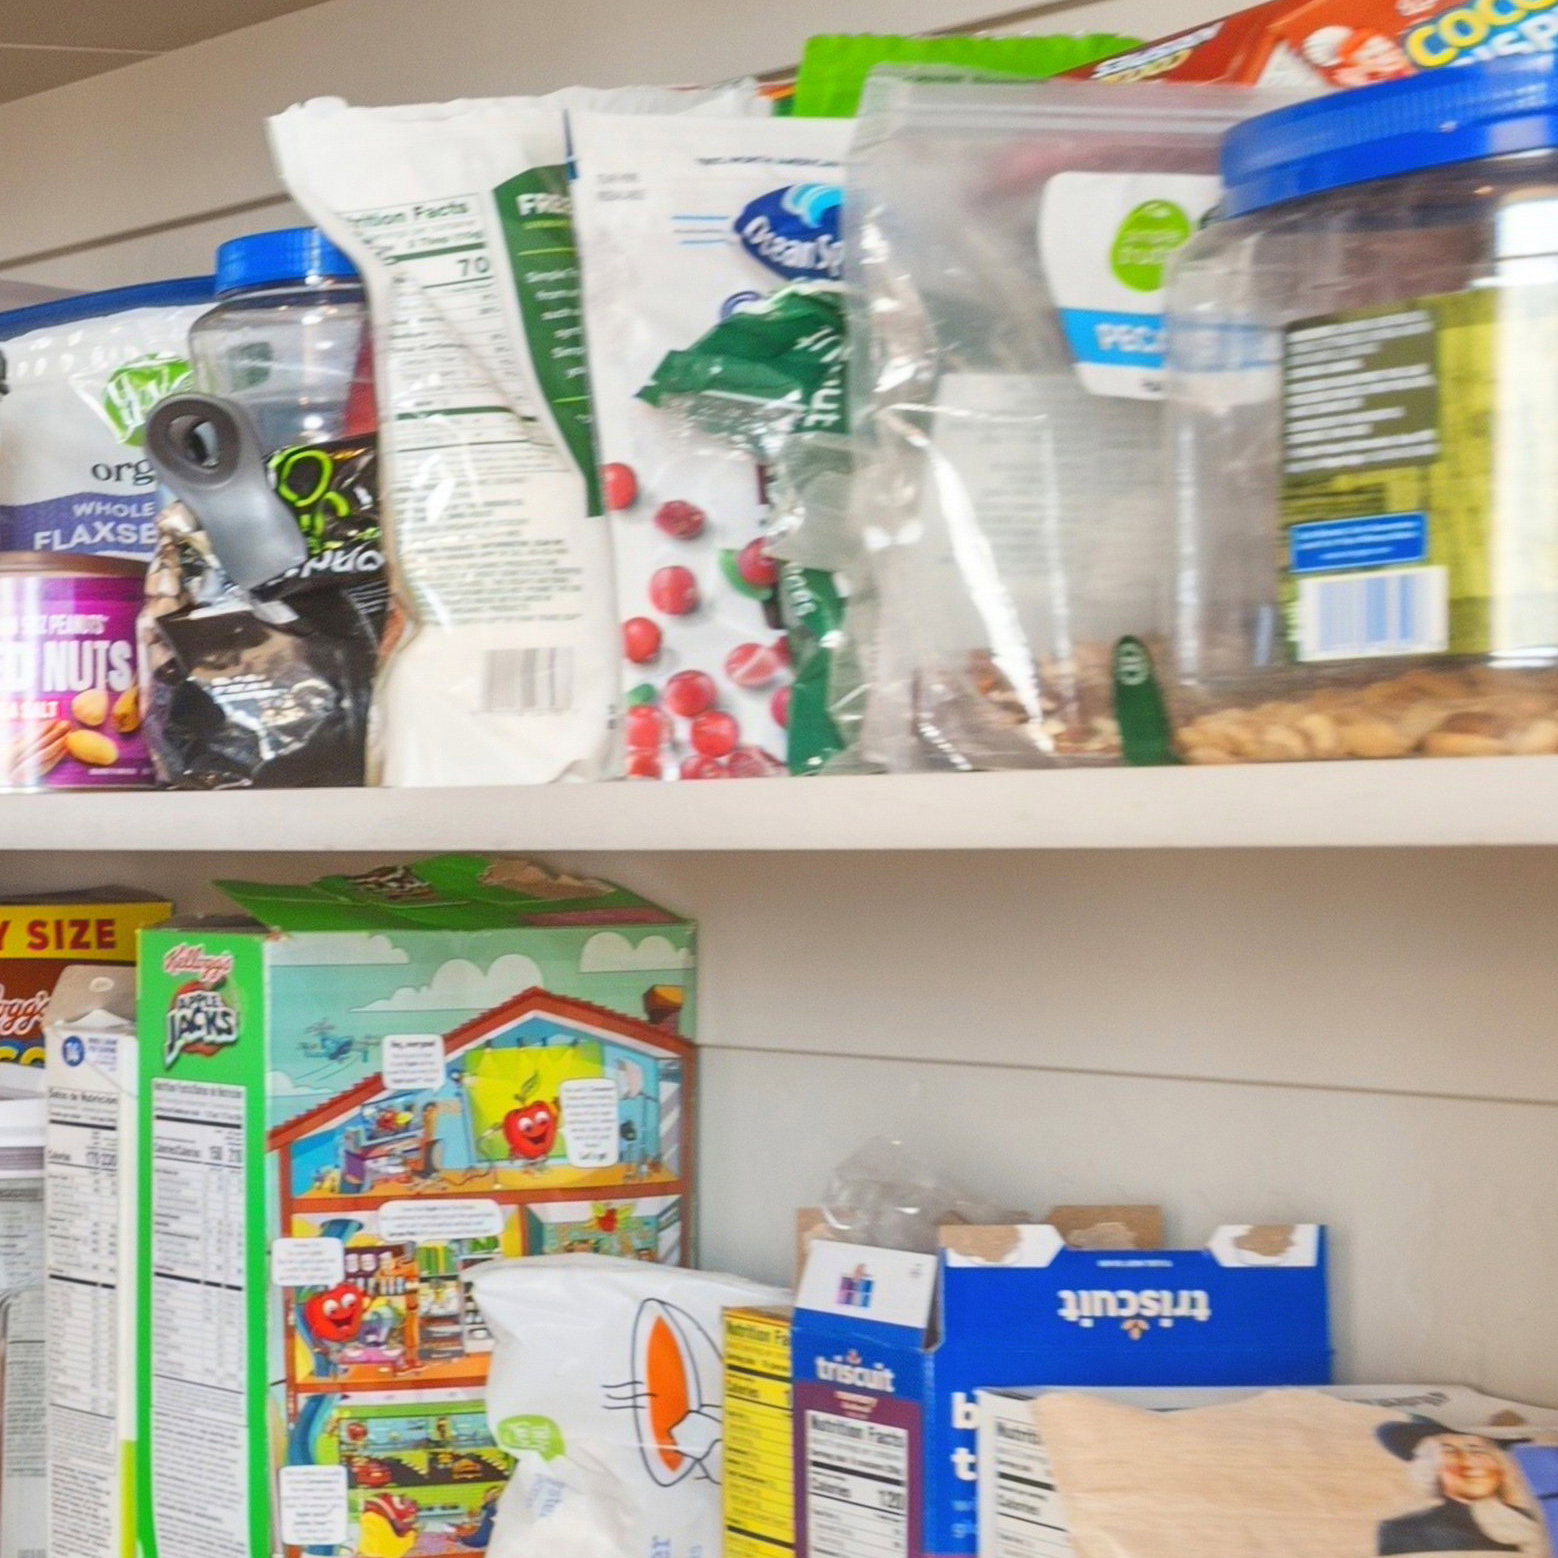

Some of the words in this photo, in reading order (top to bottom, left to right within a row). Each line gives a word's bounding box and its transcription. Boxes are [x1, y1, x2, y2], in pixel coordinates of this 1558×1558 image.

[457, 256, 491, 277] 70
[72, 499, 155, 519] WHOLE
[44, 640, 133, 692] NUTS
[21, 701, 57, 719] SALT
[26, 918, 119, 953] SIZE
[179, 995, 219, 1009] APPLE
[165, 1009, 237, 1065] JACKS
[1058, 1290, 1212, 1328] triscuit
[816, 1357, 896, 1392] triscuit
[810, 1415, 863, 1441] Nutrition
[866, 1428, 906, 1448] Facts
[810, 1476, 852, 1499] Calories
[877, 1489, 905, 1510] 120
